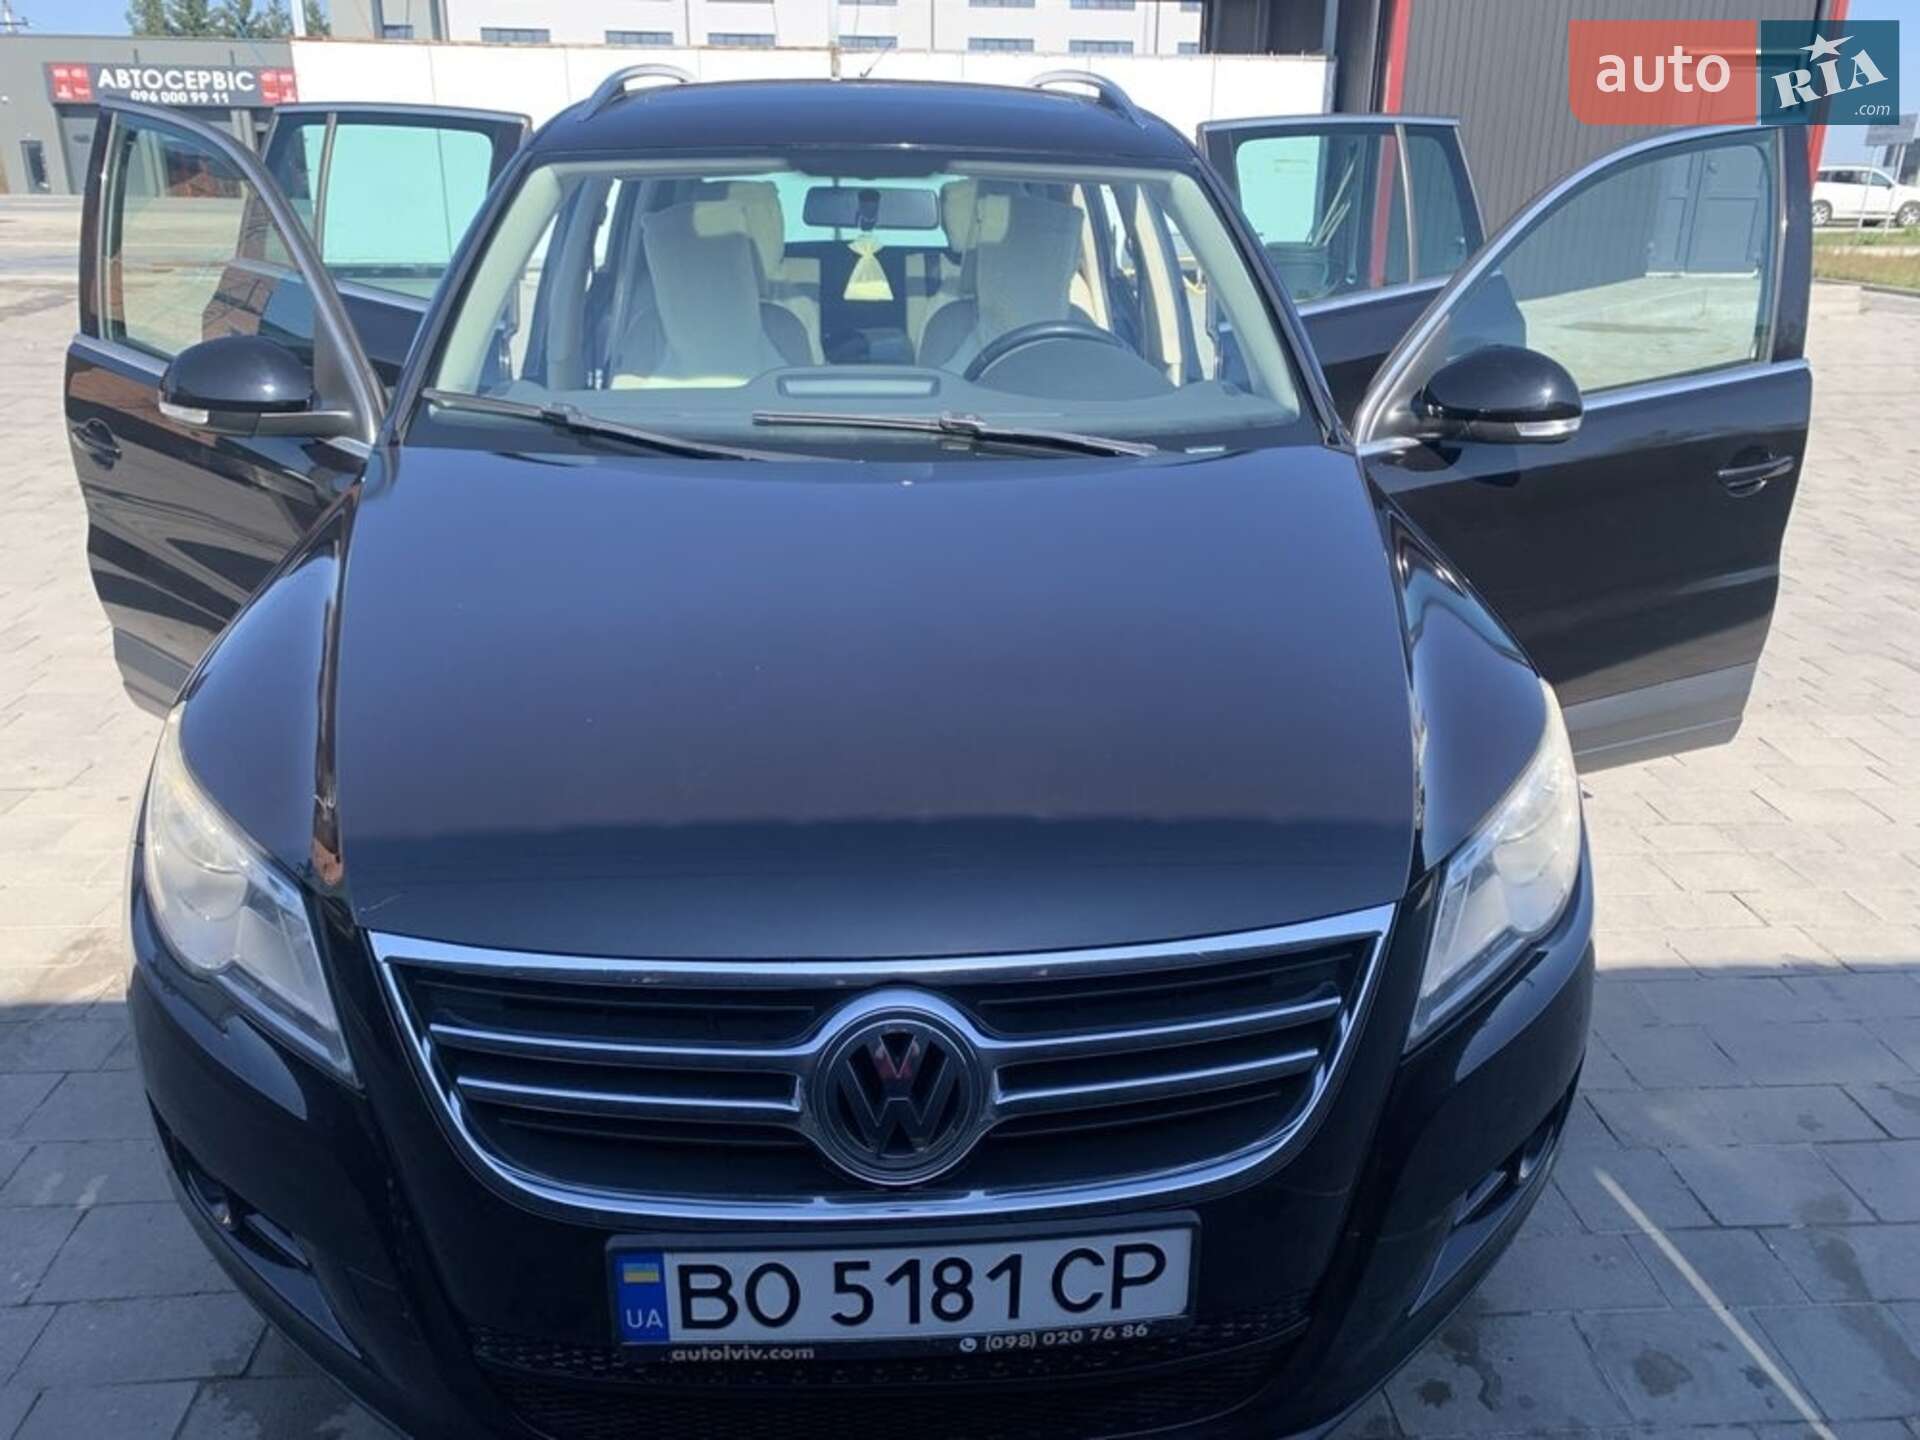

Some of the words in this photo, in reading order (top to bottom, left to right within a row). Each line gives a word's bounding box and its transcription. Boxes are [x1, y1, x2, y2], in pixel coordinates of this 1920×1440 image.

[98, 68, 255, 92] АВТОСЕРВІС
[626, 1309, 663, 1329] UA
[677, 1262, 800, 1330] BO
[830, 1253, 1022, 1327] 5181
[1051, 1242, 1167, 1314] CP
[985, 1332, 1037, 1352] (098)
[1042, 1330, 1083, 1345] 020
[1090, 1327, 1116, 1341] 76
[1122, 1324, 1148, 1338] 86
[671, 1346, 815, 1361] autolviv.com
